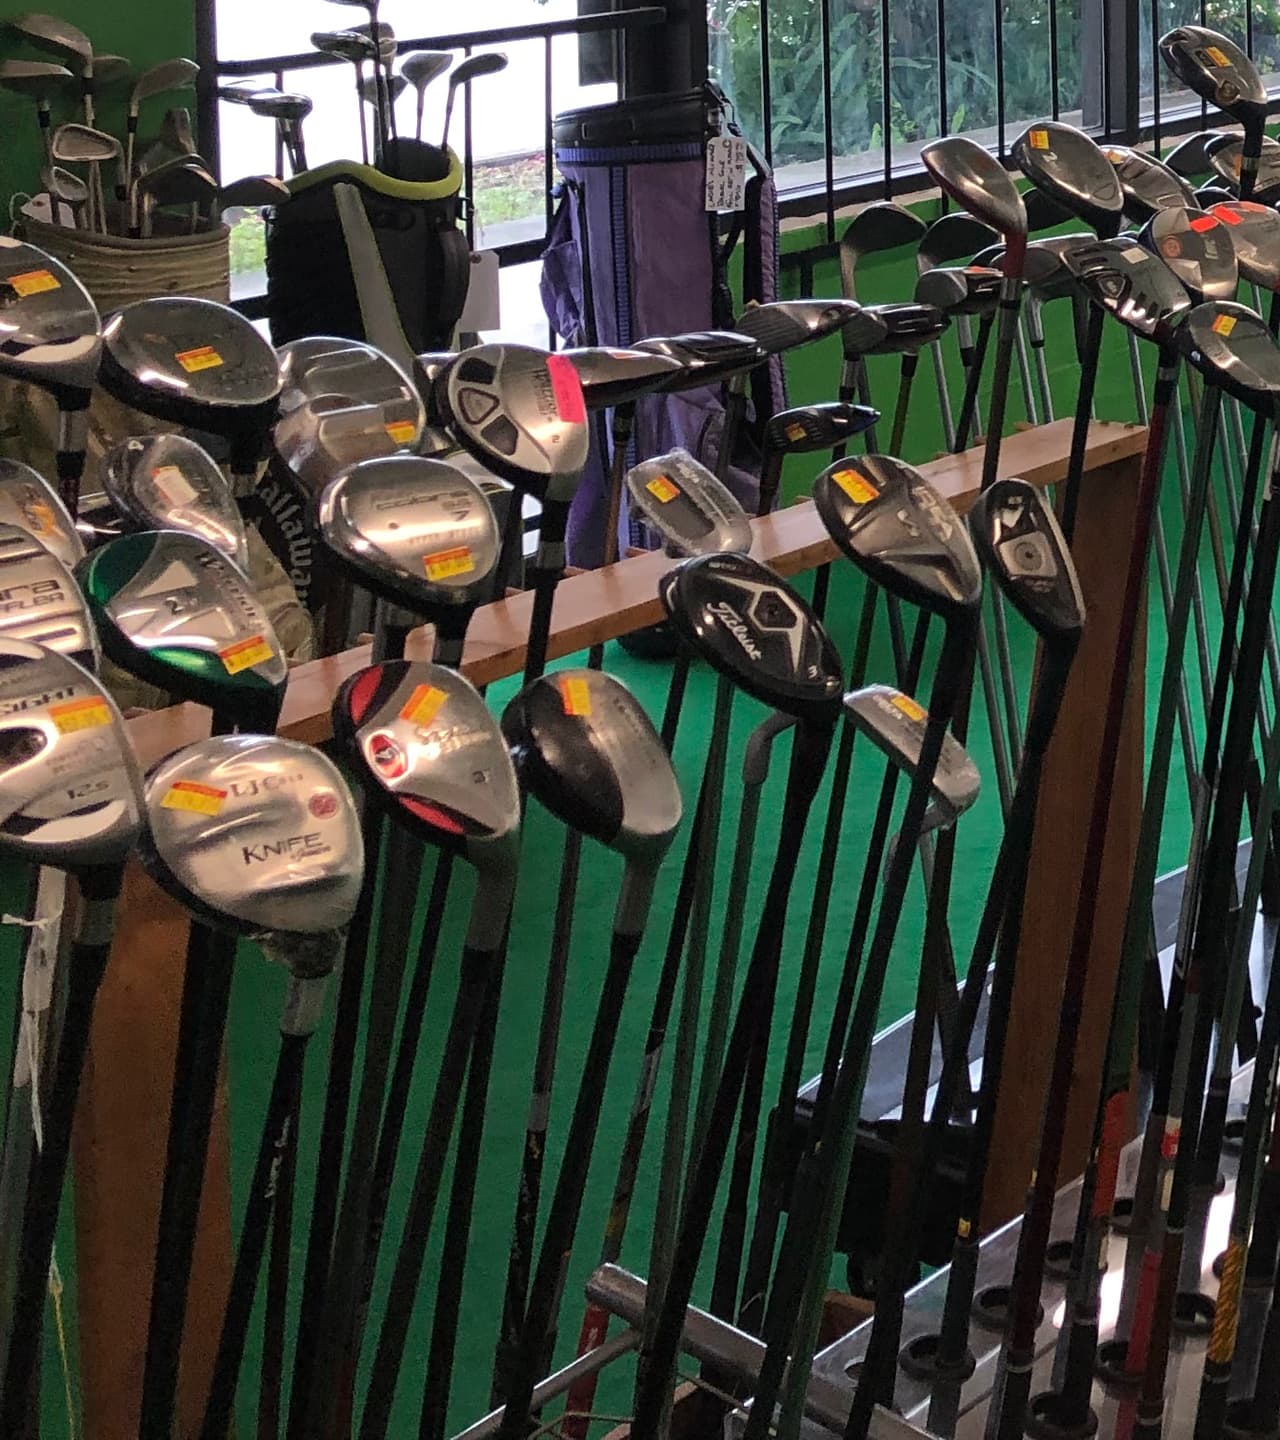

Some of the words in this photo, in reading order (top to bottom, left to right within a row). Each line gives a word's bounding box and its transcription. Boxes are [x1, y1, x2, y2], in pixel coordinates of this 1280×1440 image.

[258, 480, 313, 608] allawa
[706, 601, 763, 660] Titleist
[242, 832, 324, 865] KNIFE
